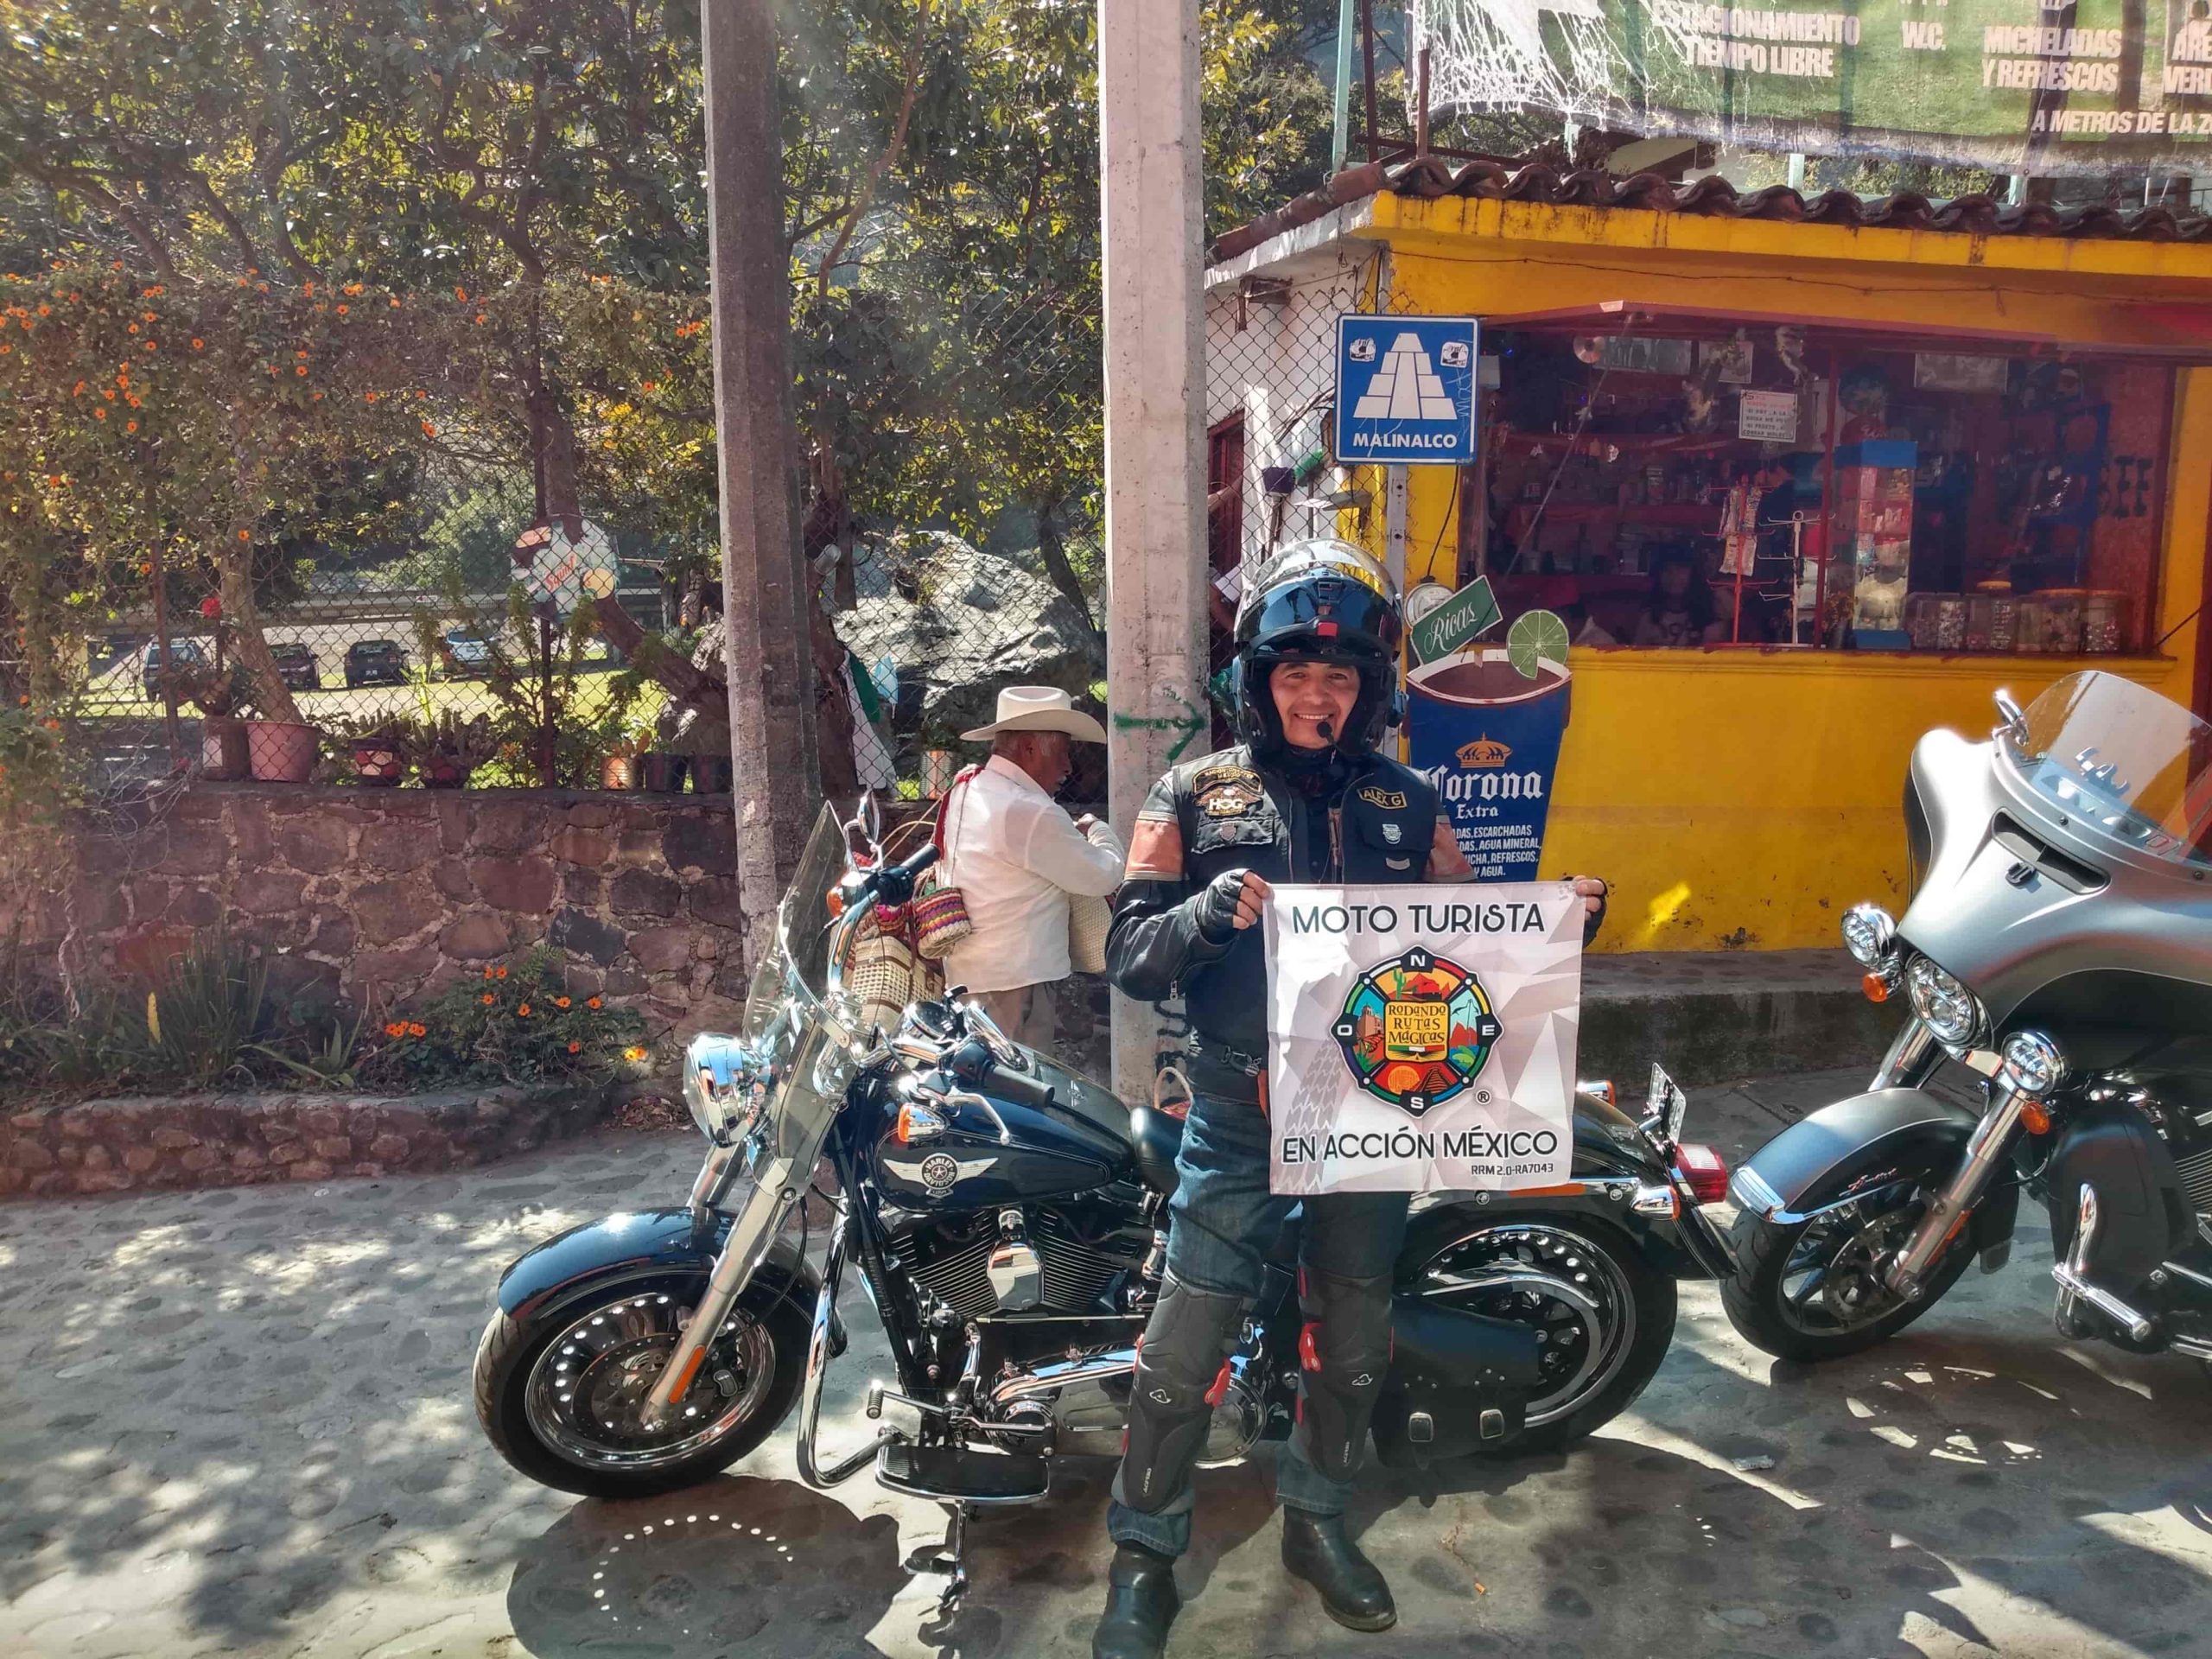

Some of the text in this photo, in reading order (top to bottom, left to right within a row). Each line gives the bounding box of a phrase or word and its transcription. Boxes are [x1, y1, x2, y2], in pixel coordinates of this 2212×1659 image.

[1901, 21, 1946, 51] W.C.
[1984, 26, 2122, 58] MICHELADAS
[1682, 35, 1834, 78] TIEMPO LIBRE
[1981, 59, 2120, 92] Y REFRESCOS
[2031, 110, 2045, 132] A
[2049, 110, 2133, 133] METROS
[2136, 111, 2165, 134] DE
[2168, 112, 2193, 134] LA
[1352, 433, 1458, 448] MALINALCO
[1424, 601, 1478, 655] Ricas
[1426, 765, 1544, 802] Corona
[1363, 788, 1402, 806] ALEX G
[1455, 804, 1499, 819] Extra
[1478, 838, 1503, 851] AGUA
[1292, 903, 1545, 934] MOTO TURISTA
[1409, 954, 1426, 967] N
[1337, 1024, 1353, 1036] O
[1481, 1025, 1495, 1036] E
[1410, 1096, 1425, 1109] S
[1282, 1126, 1558, 1163] EN ACCIÓN MÉXICO
[925, 1157, 955, 1171] HARLEY
[1471, 1162, 1554, 1176] RRM 2.0-RA7043
[923, 1171, 956, 1187] DAVIDSON
